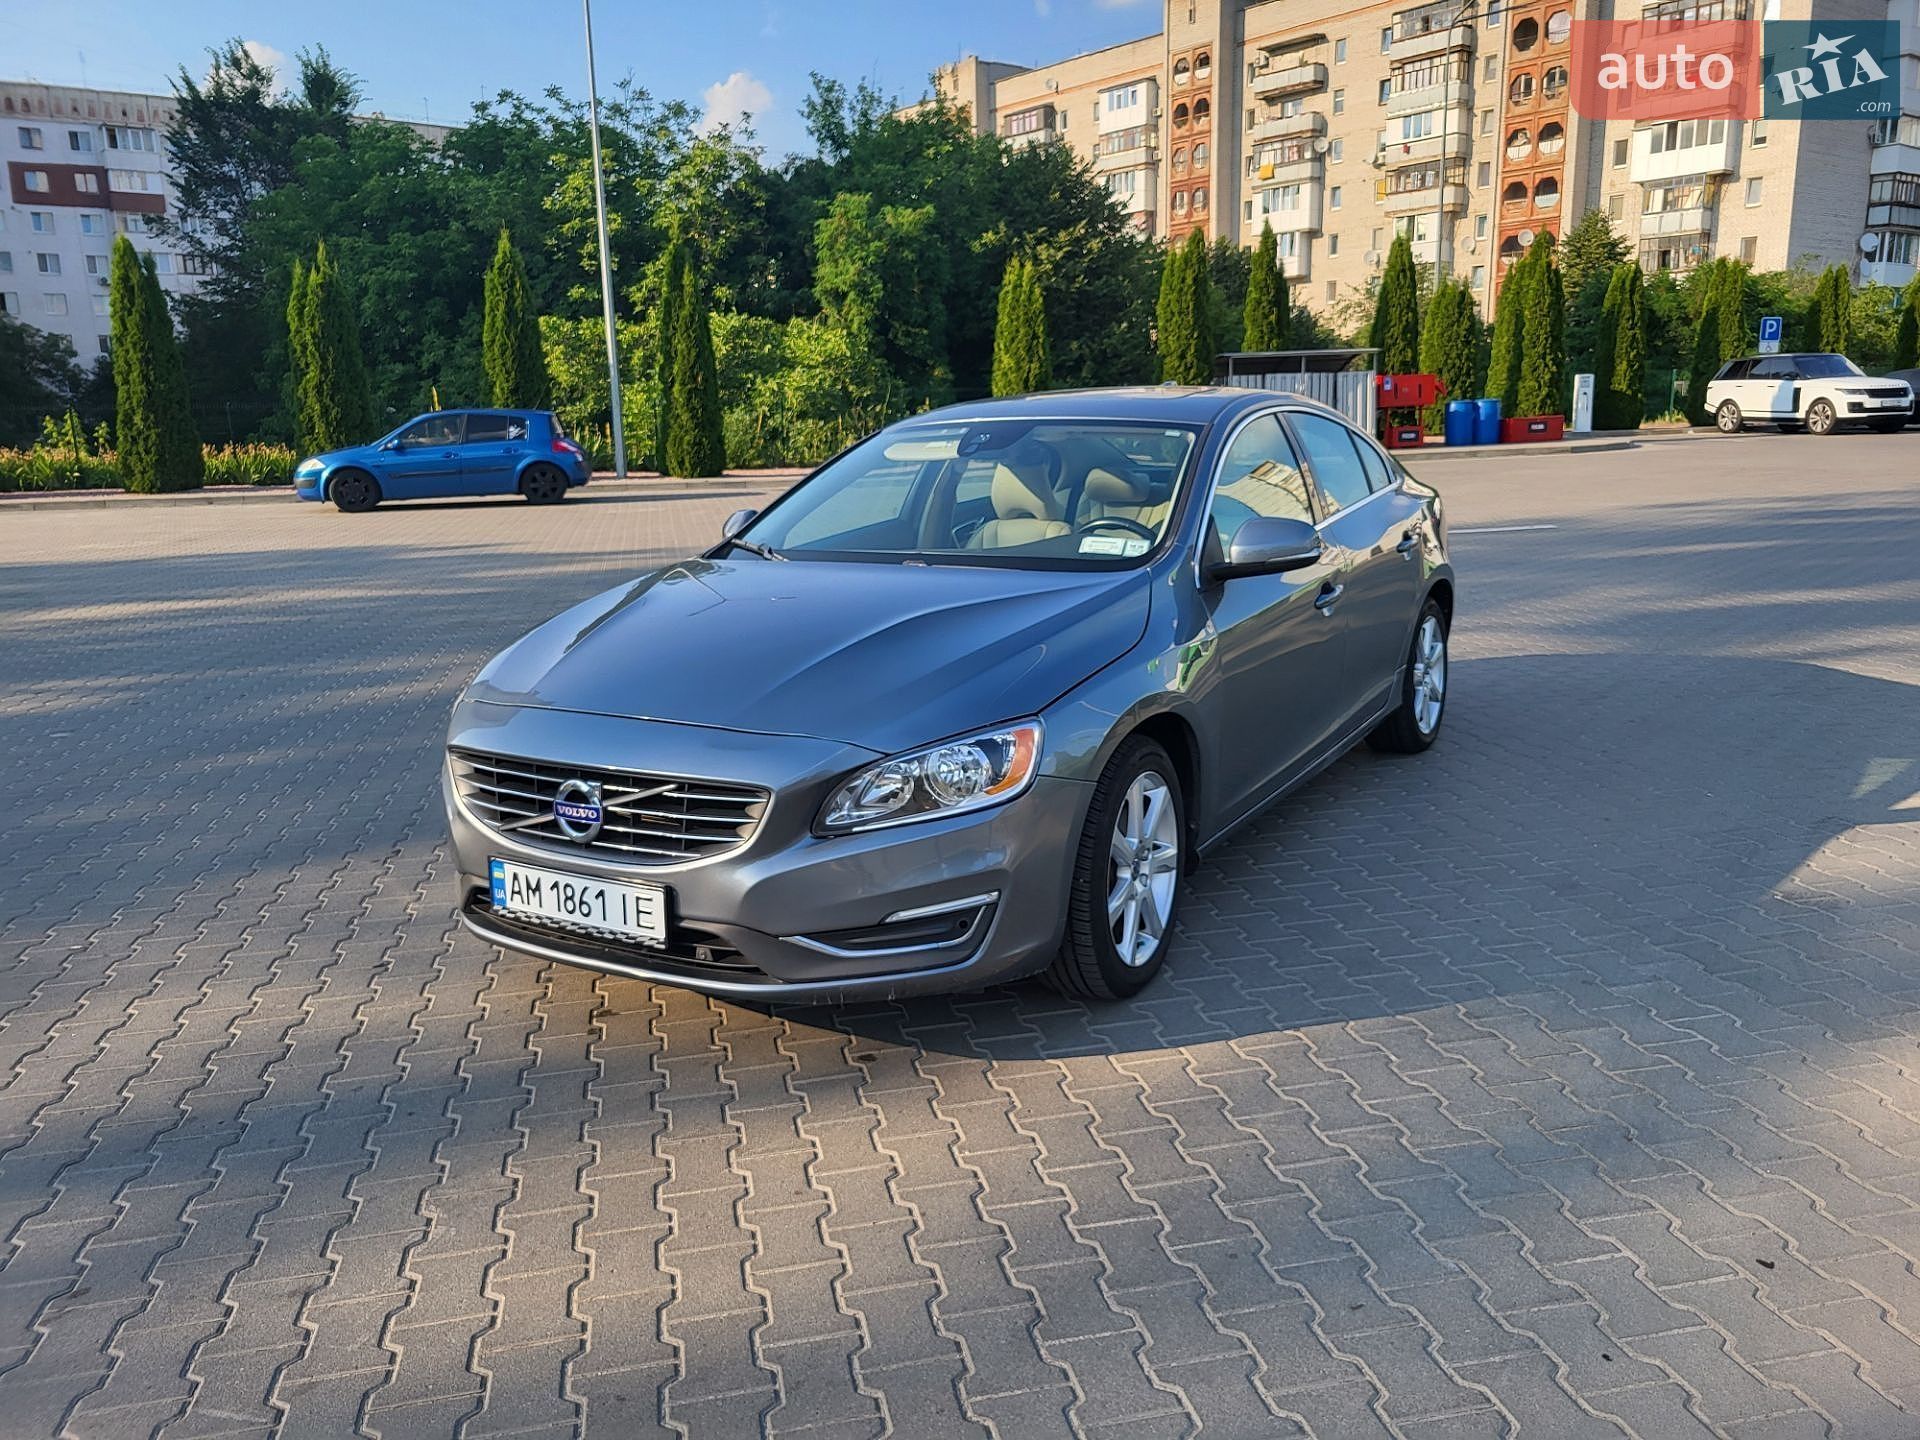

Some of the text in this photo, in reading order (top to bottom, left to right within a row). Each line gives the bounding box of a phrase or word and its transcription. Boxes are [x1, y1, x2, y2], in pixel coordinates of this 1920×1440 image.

[1765, 320, 1777, 339] P
[556, 805, 598, 819] VOLVO
[495, 887, 506, 899] UA
[550, 880, 607, 921] 1861
